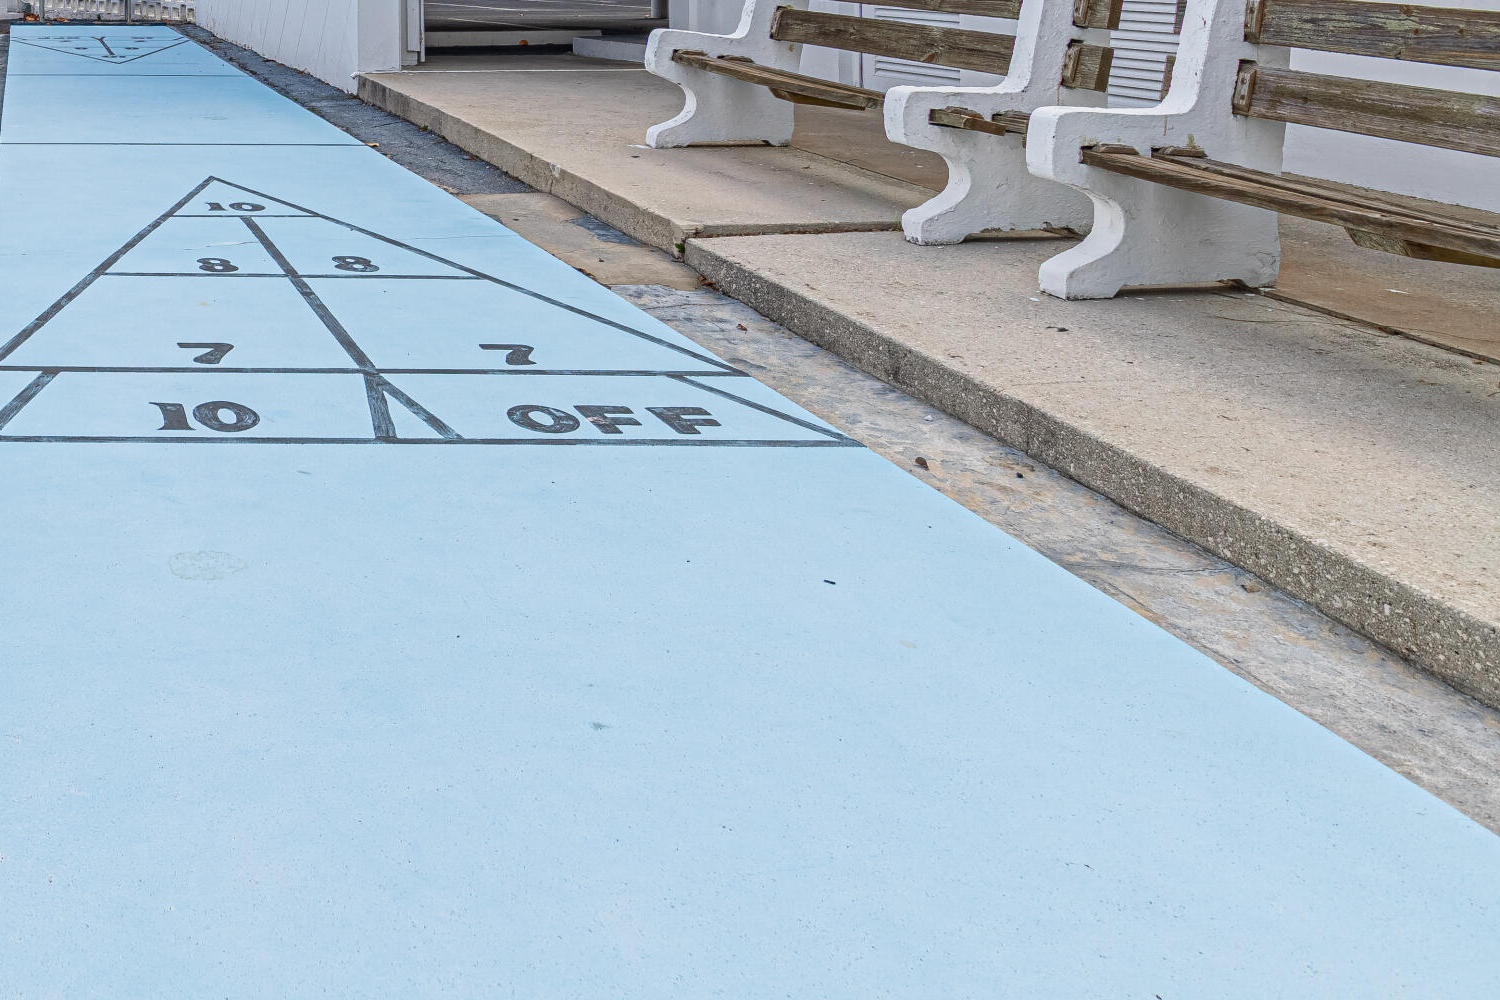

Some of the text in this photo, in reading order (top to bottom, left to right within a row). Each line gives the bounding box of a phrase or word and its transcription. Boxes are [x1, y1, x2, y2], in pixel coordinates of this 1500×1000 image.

[207, 200, 266, 213] 10
[197, 255, 380, 274] 8 8
[176, 341, 537, 367] 7 7
[150, 400, 724, 436] 10 OFF
